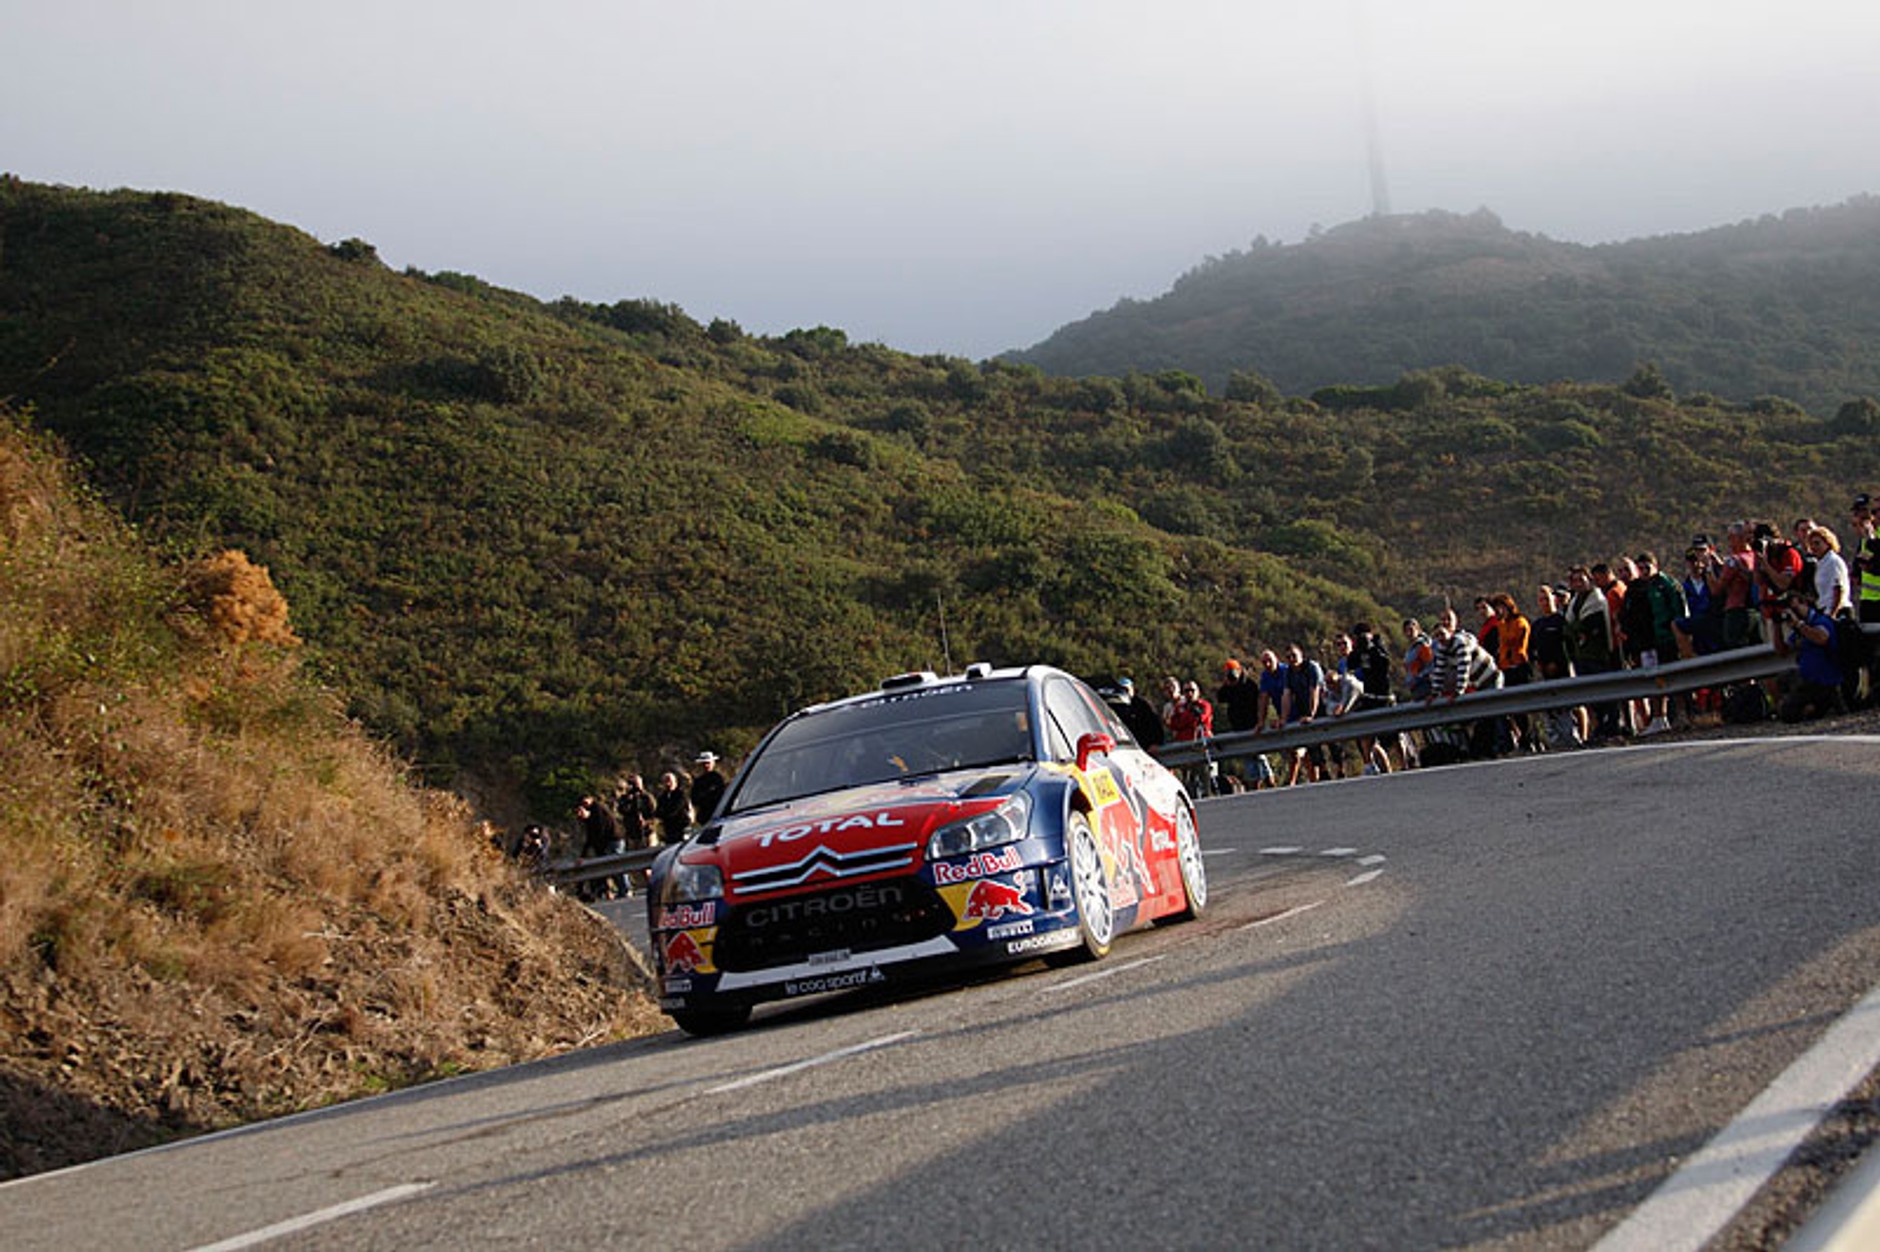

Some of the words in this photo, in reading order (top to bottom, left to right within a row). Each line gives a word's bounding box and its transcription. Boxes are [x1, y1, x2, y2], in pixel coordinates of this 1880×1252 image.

[754, 812, 904, 848] TOTAL
[934, 856, 985, 885] Red
[984, 846, 1024, 875] Bull
[679, 901, 715, 927] Bull
[745, 883, 903, 928] CITROËN
